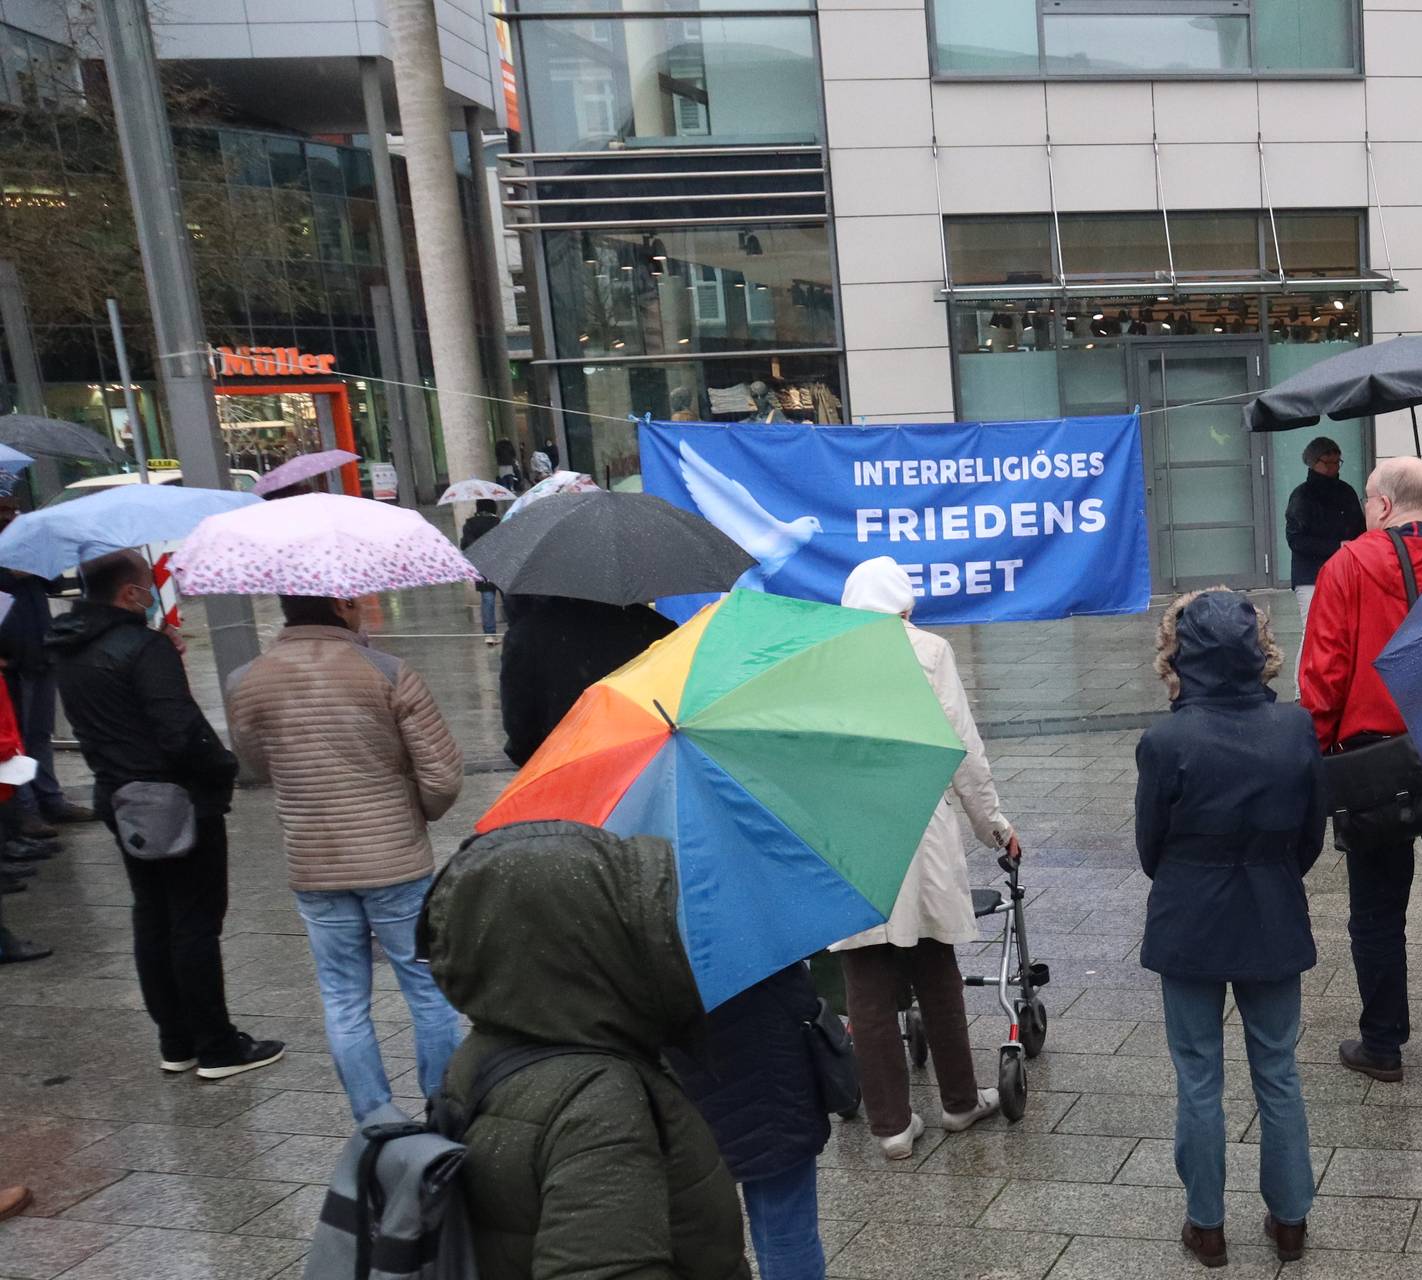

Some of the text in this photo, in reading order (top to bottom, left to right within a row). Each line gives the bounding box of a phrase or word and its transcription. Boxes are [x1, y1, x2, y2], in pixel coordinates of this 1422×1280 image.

[218, 346, 336, 376] Müller
[853, 450, 1105, 487] INTERRELIGIÖSES
[855, 498, 1107, 543] FRIEDENS
[900, 558, 1024, 597] EBET
